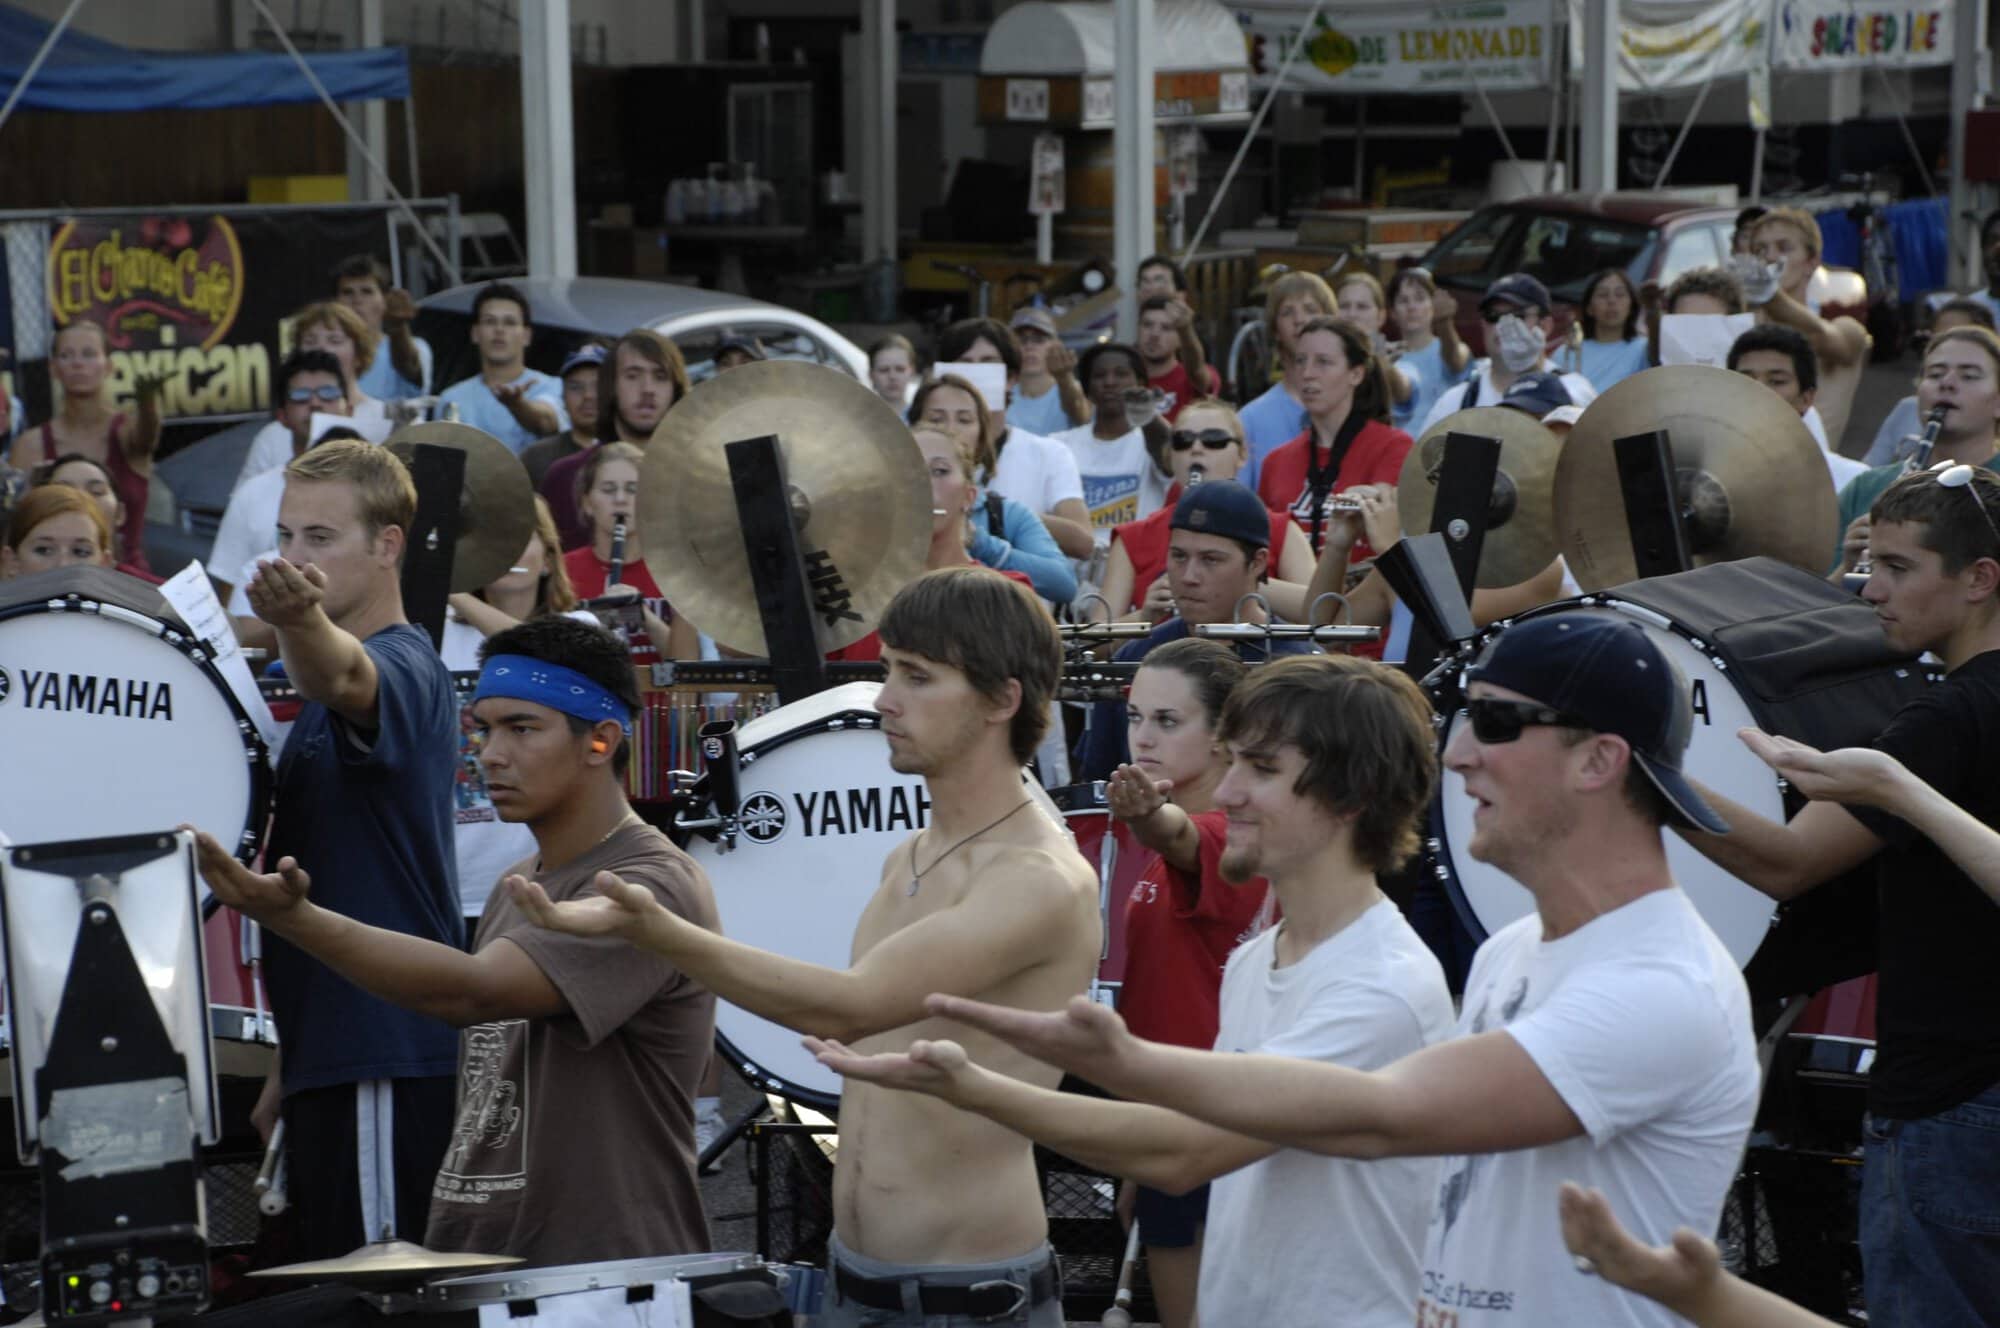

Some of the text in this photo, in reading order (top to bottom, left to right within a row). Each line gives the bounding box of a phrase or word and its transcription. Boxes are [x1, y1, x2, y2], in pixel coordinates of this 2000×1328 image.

[1399, 24, 1542, 62] LEMONADE
[1810, 10, 1941, 57] SHAVED ICE
[53, 324, 270, 416] exican
[20, 669, 172, 721] YAMAHA
[793, 785, 931, 837] YAMAH
